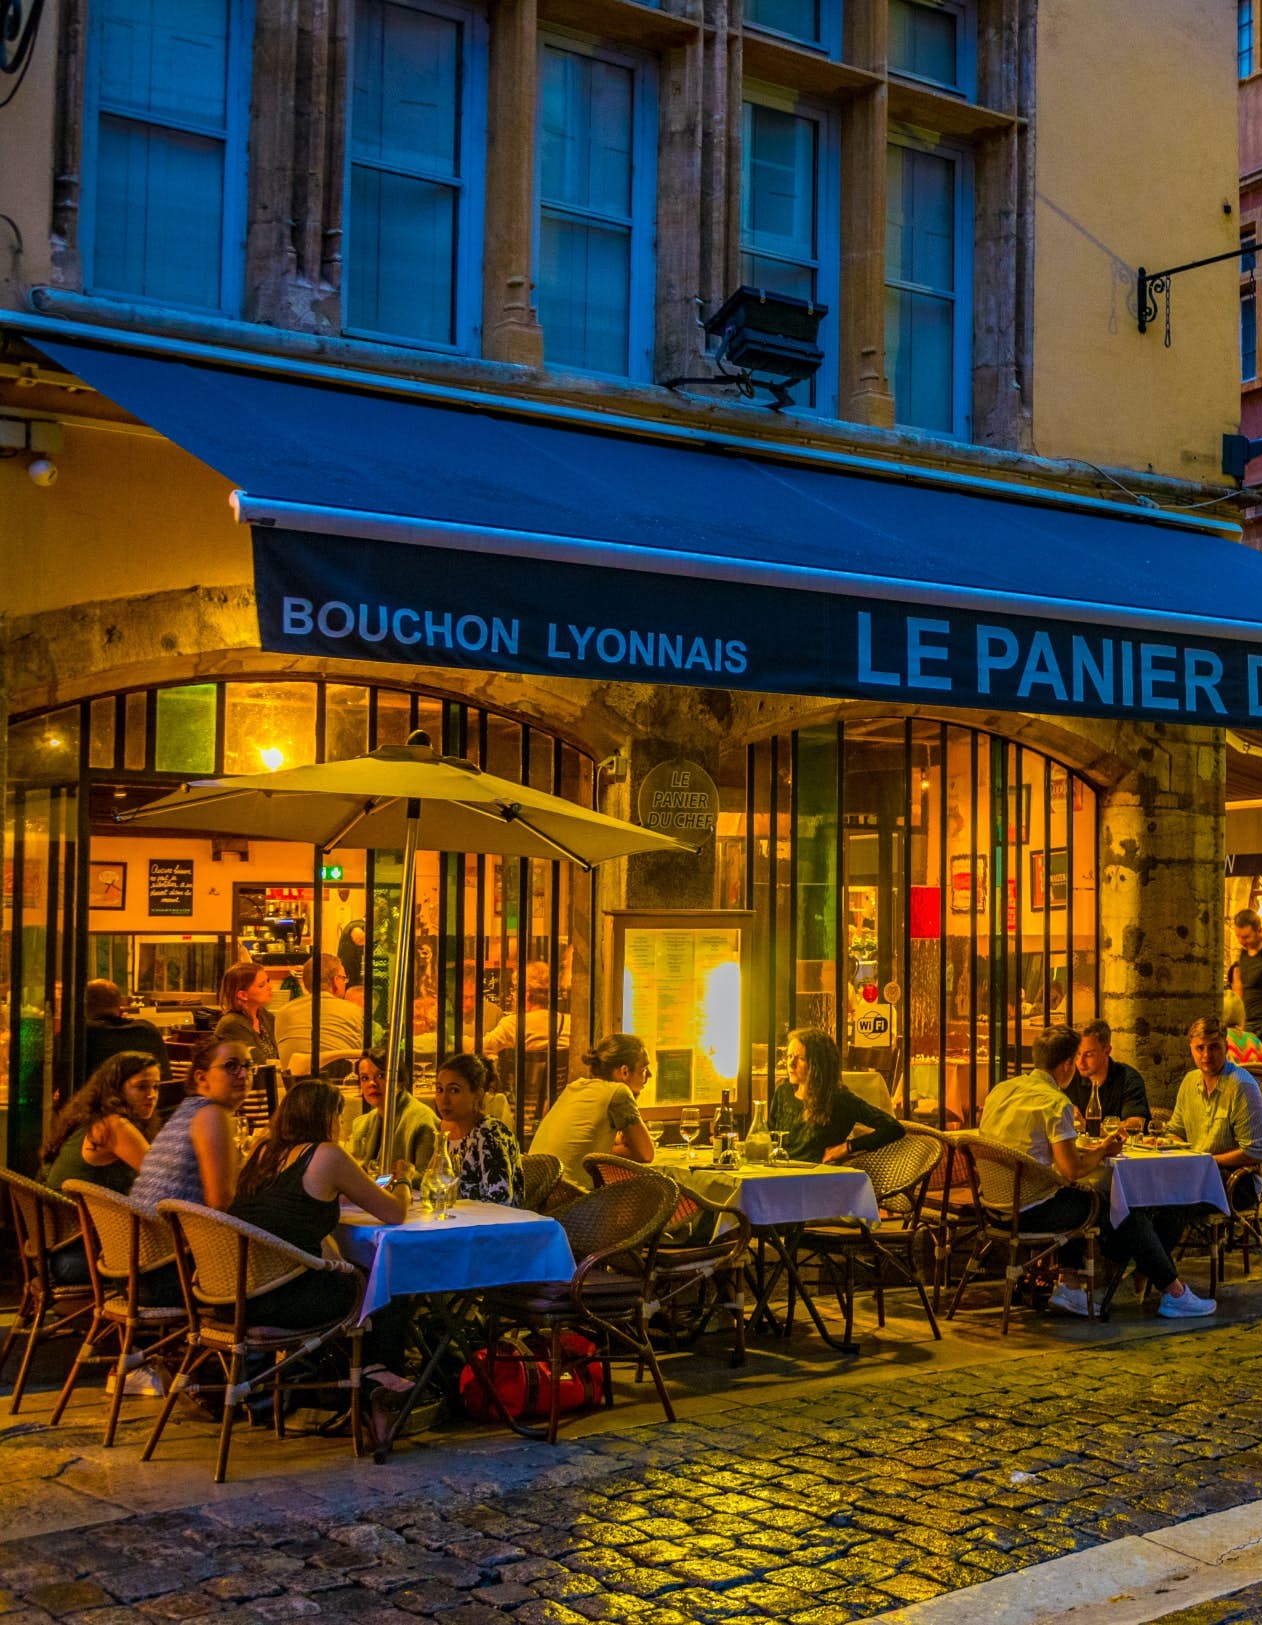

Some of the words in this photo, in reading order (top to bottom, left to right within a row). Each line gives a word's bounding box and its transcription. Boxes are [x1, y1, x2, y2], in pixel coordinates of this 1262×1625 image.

[282, 596, 520, 655] BOUCHON
[547, 622, 749, 675] LYONNAIS
[857, 611, 950, 690] LE
[976, 624, 1225, 714] PANIER
[671, 771, 691, 788] LE
[652, 791, 709, 809] PANIER
[648, 812, 672, 829] DU
[674, 813, 714, 830] CHEF
